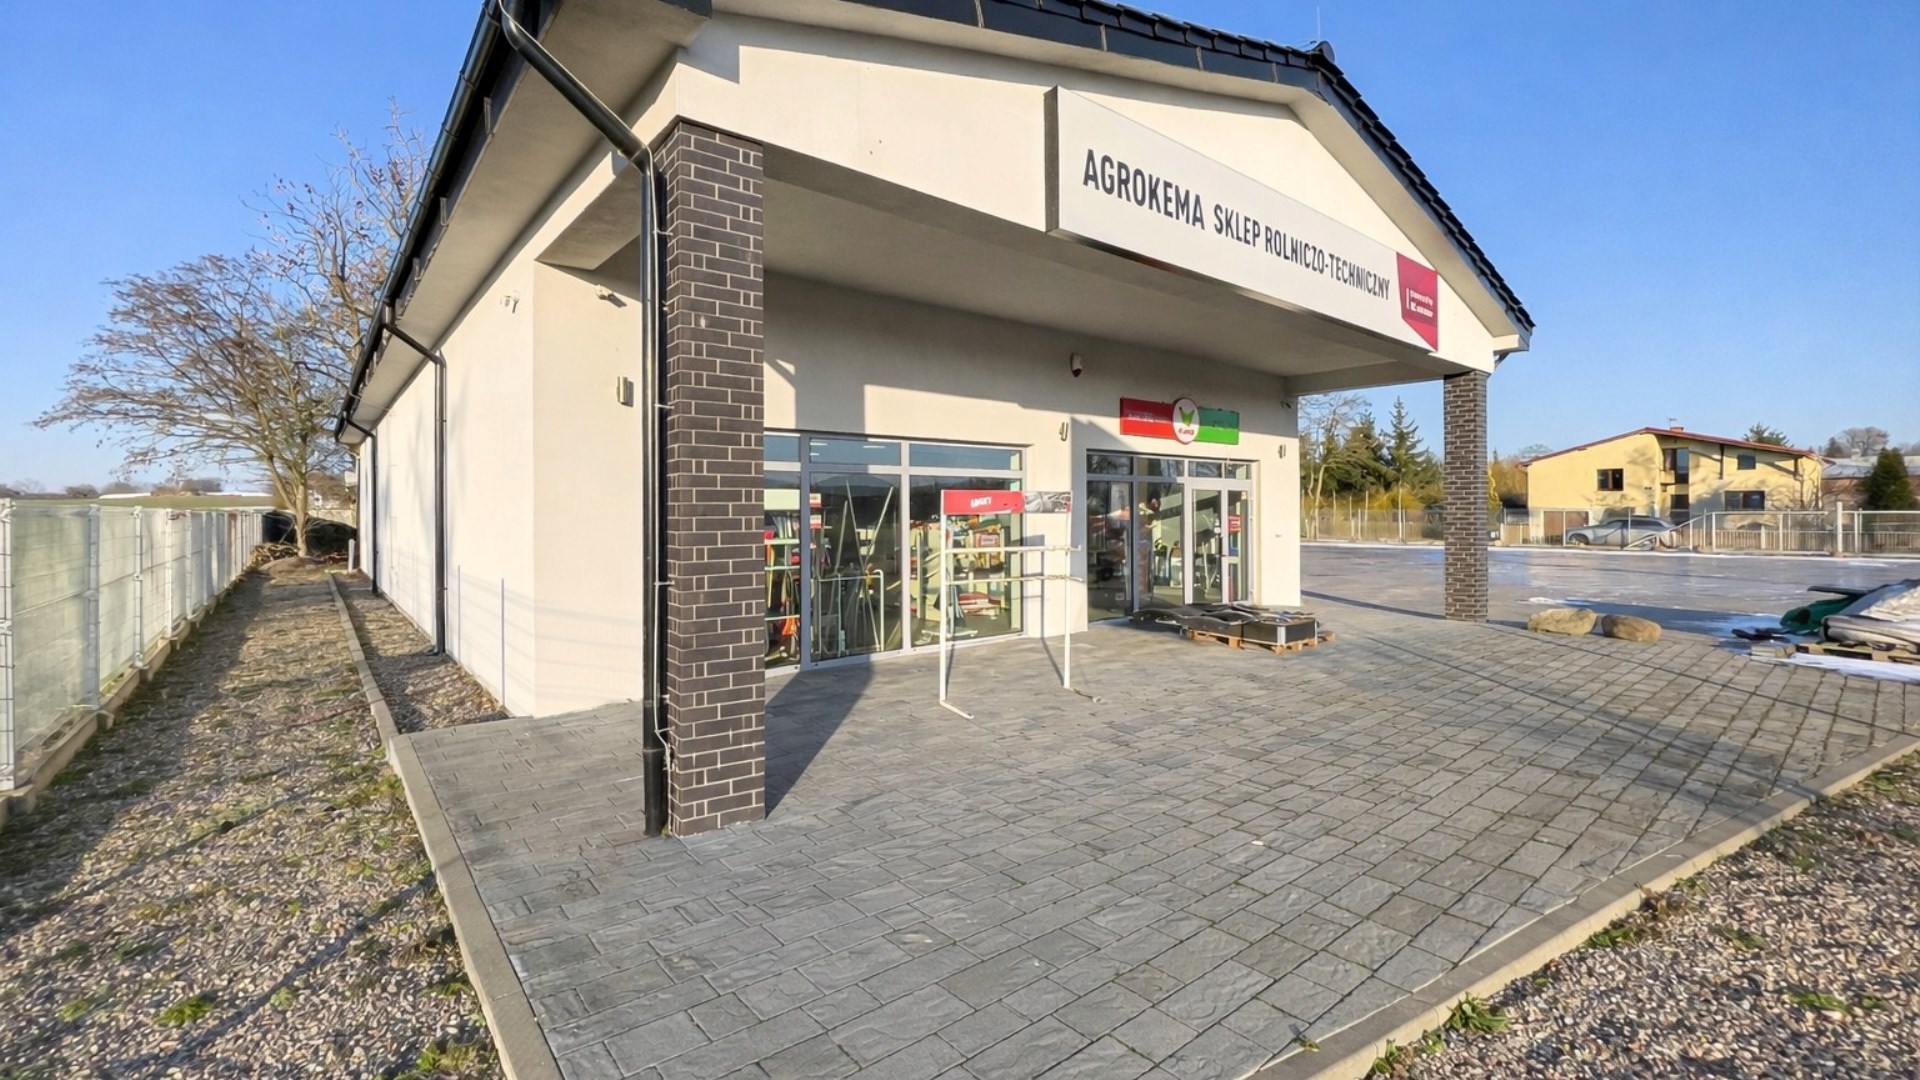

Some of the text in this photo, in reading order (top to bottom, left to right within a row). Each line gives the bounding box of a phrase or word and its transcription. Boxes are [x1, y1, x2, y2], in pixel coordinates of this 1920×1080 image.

[1083, 148, 1390, 300] AGROKEMA SKLEP ROLNICZO-TECHNICZNY
